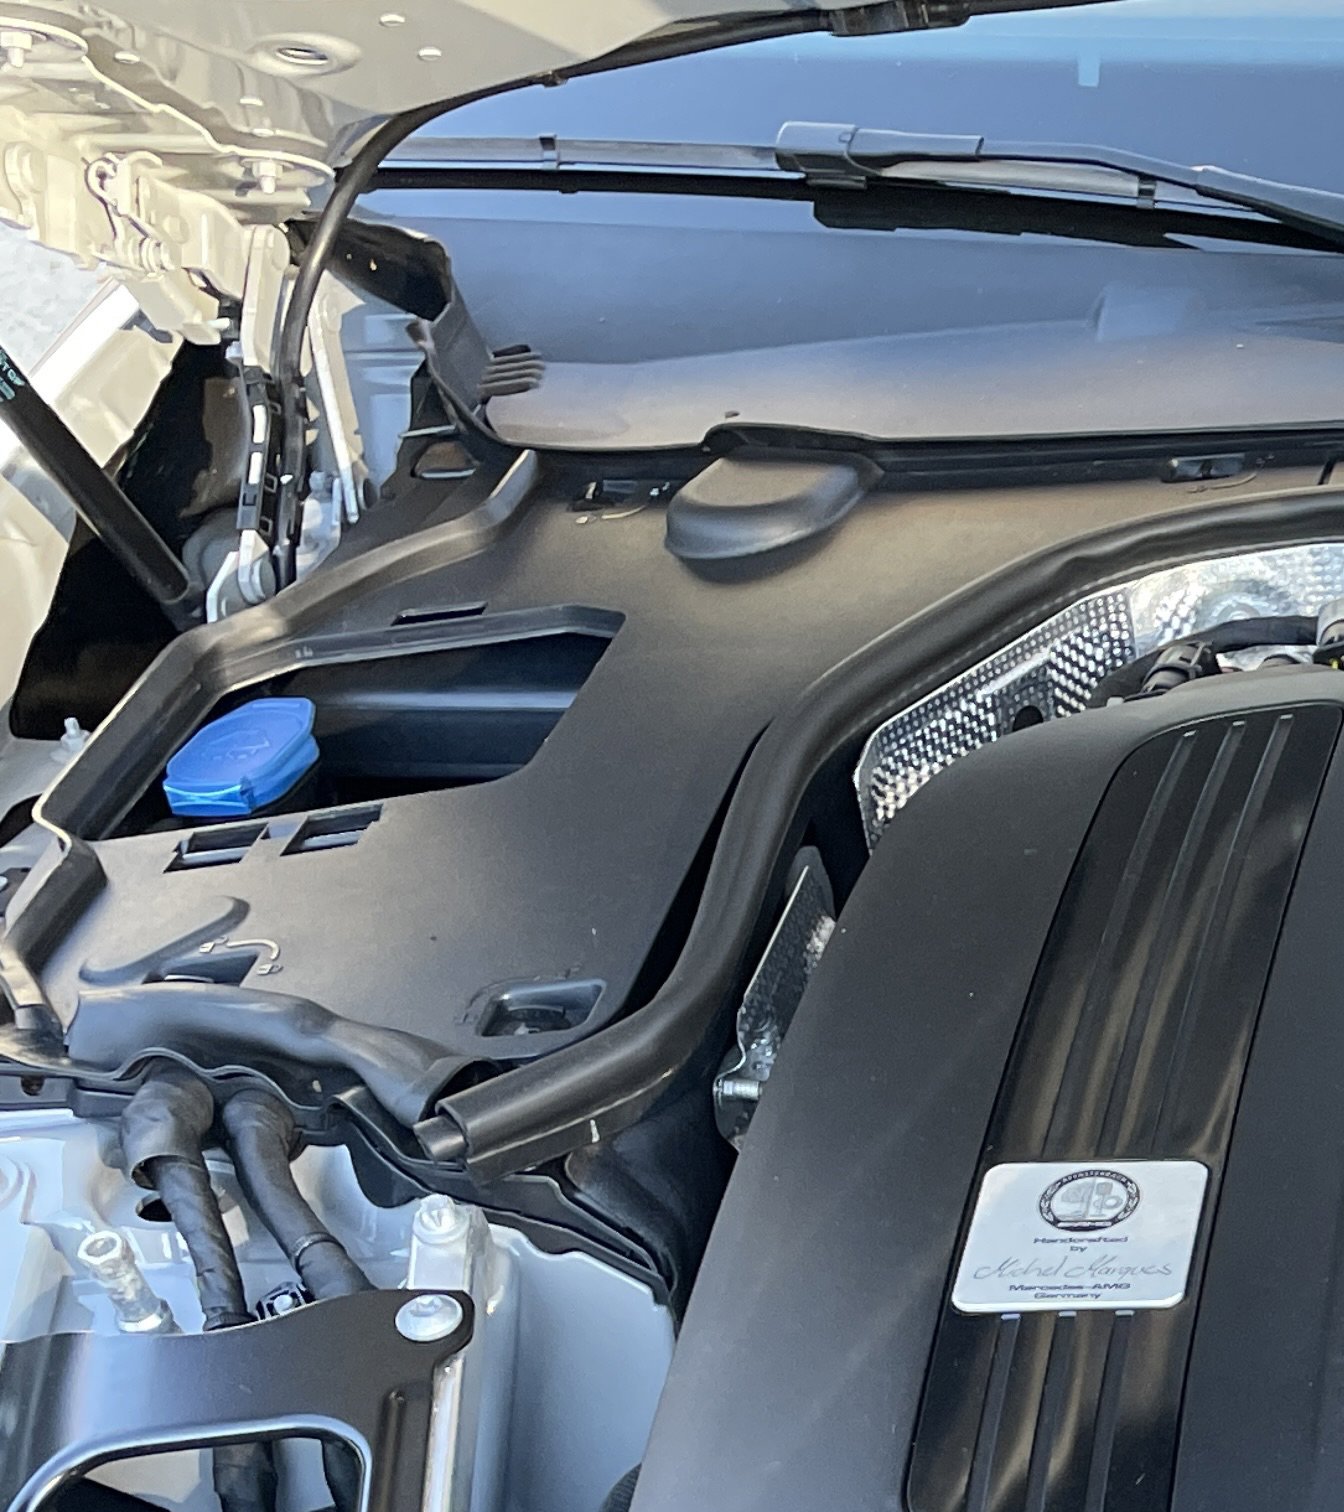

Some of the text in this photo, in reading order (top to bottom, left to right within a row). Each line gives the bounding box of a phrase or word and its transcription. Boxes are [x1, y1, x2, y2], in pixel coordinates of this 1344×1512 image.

[1033, 1236, 1129, 1244] Handcrafted
[1008, 1282, 1131, 1292] Mercedes-AMG
[1034, 1291, 1101, 1300] Germany
